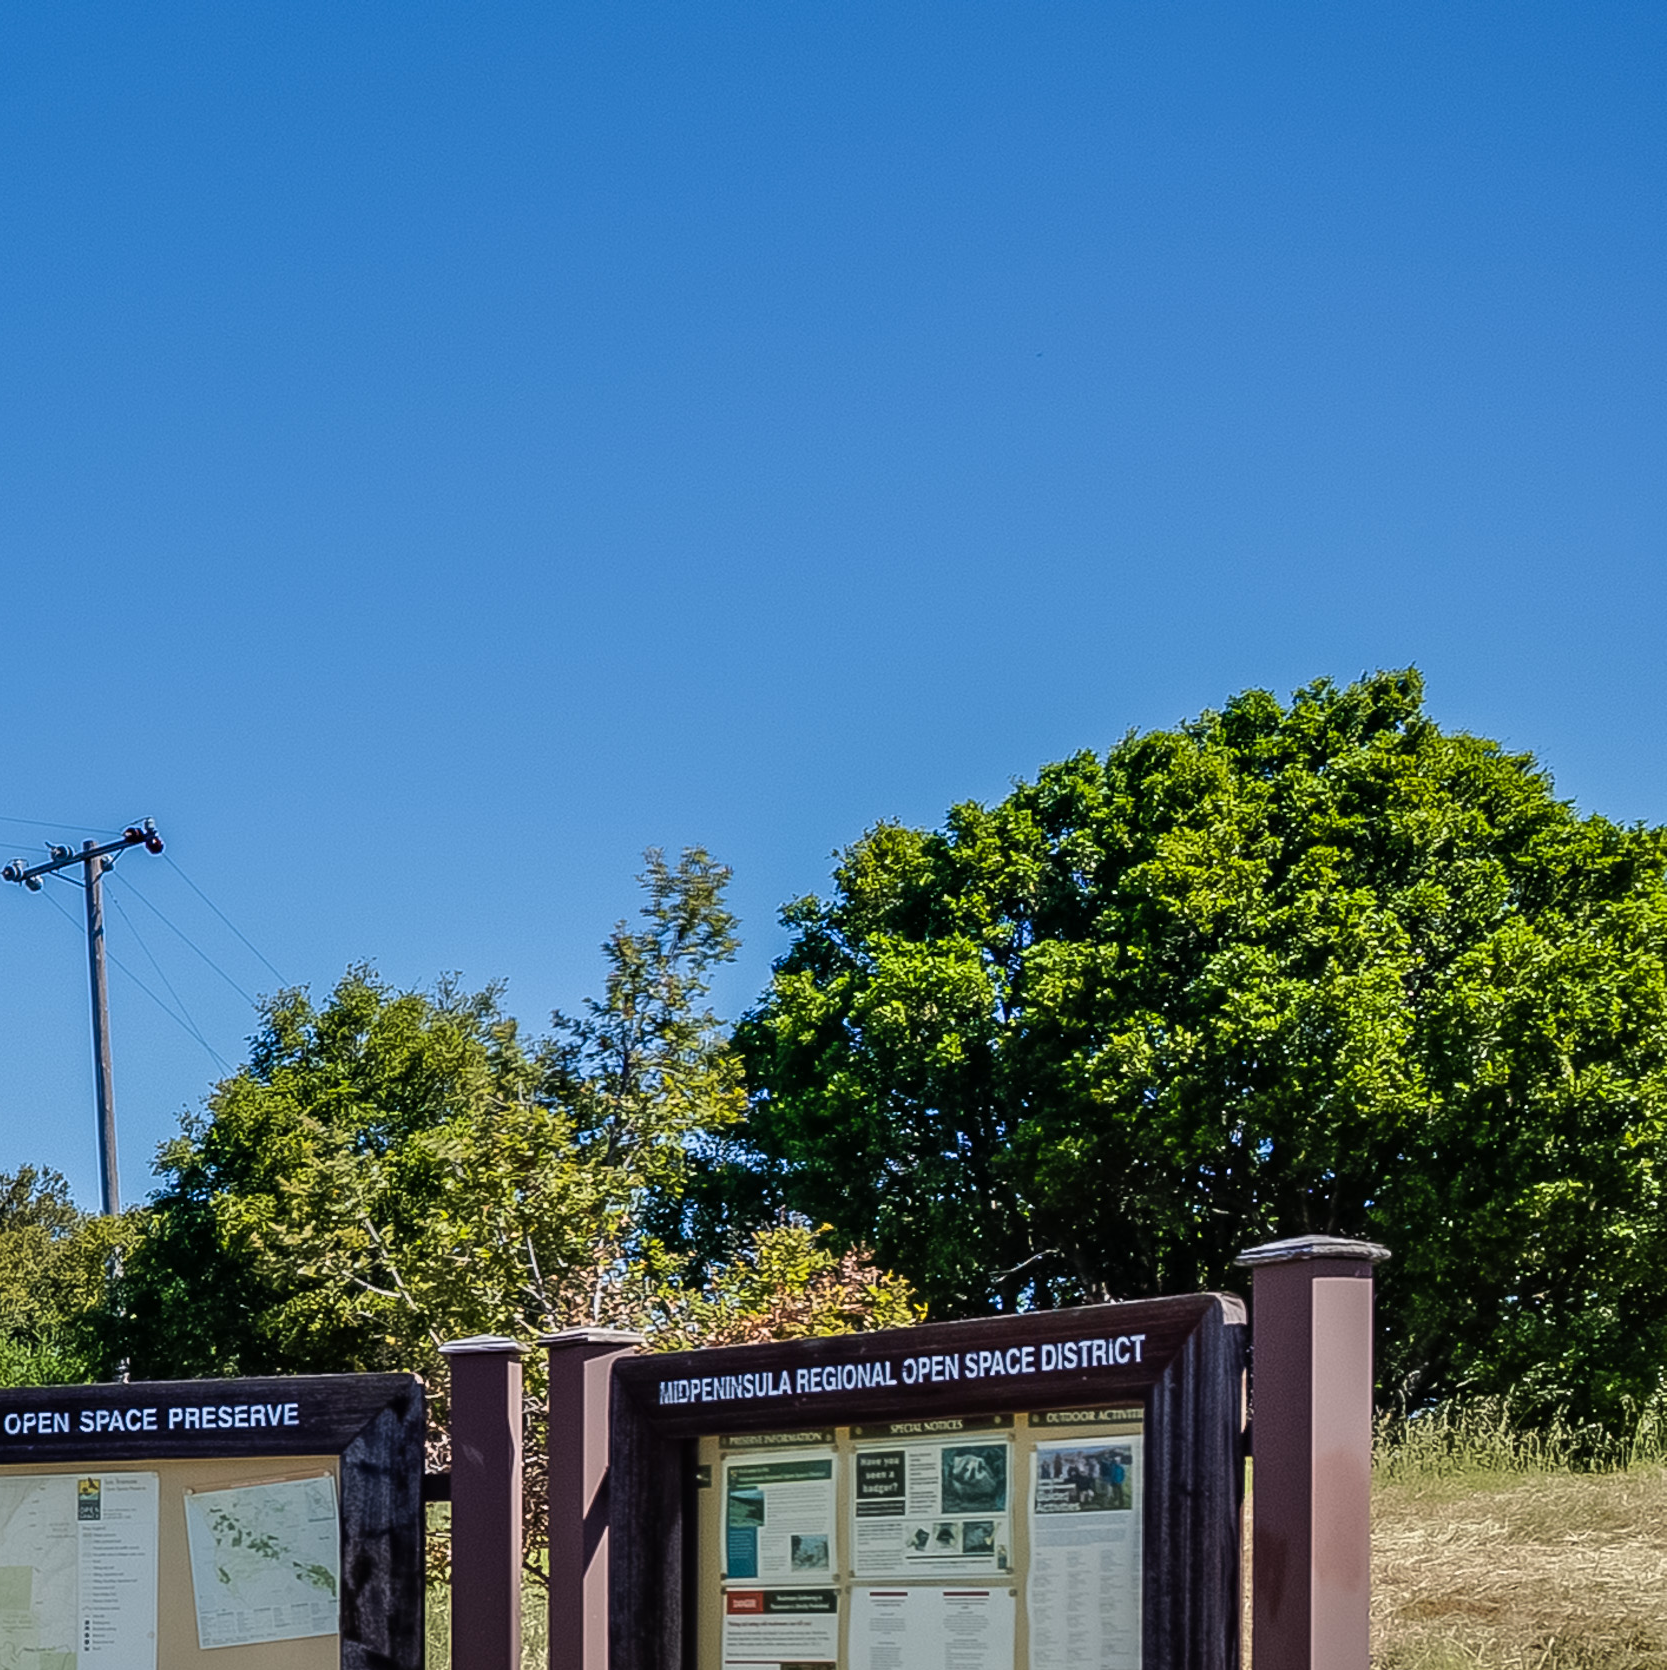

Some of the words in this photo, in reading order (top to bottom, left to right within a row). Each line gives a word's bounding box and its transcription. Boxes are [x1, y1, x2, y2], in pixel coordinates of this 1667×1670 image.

[659, 1369, 792, 1405] MIDPENINSULA
[796, 1360, 897, 1395] REGIONAL
[902, 1353, 959, 1385] OPEN
[964, 1346, 1035, 1379] SPACE
[1041, 1334, 1145, 1371] DISTRICT
[4, 1411, 69, 1436] OPEN
[79, 1408, 157, 1433] SPACE
[168, 1403, 299, 1431] PRESERVE
[890, 1423, 923, 1434] SPECIAL
[924, 1419, 964, 1431] NOTICES
[1047, 1412, 1096, 1423] OUTDOOR
